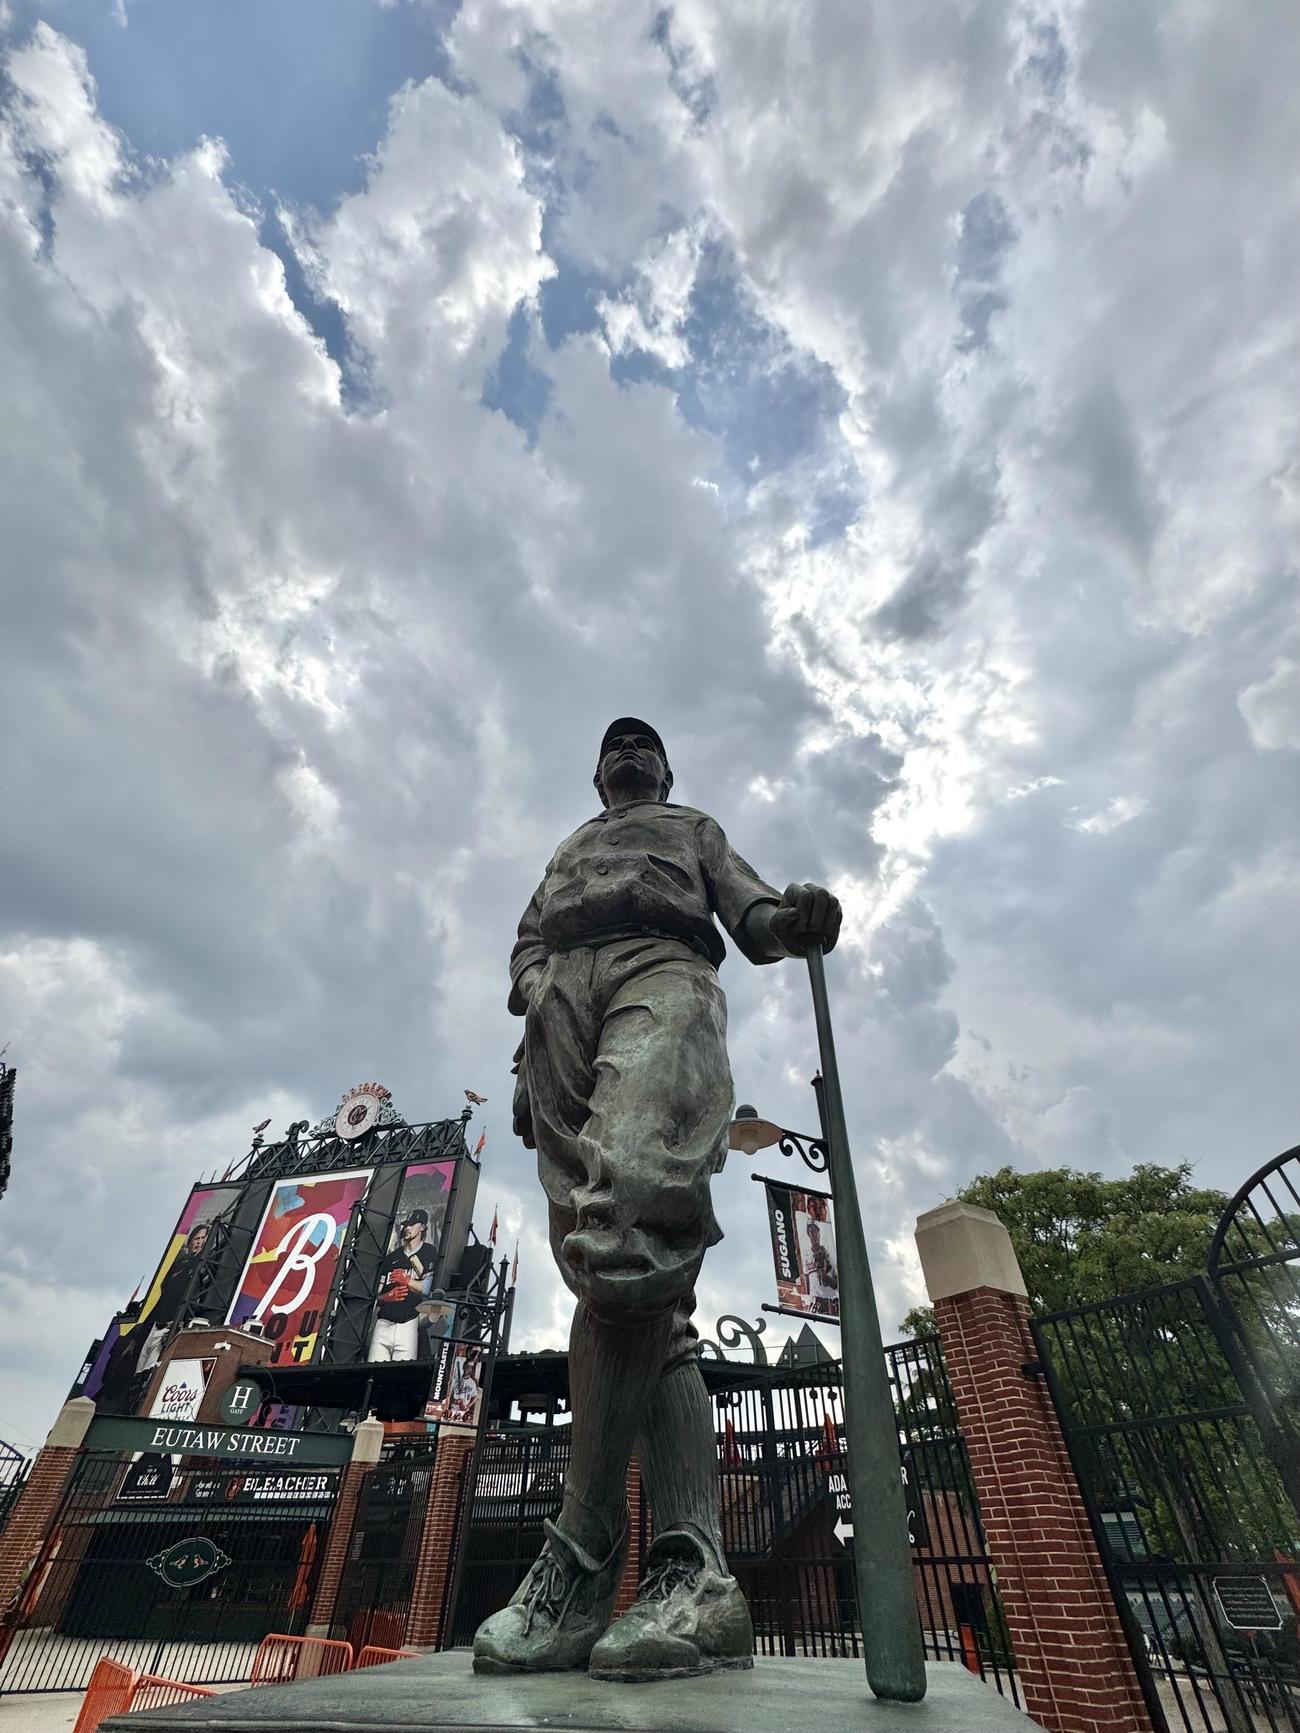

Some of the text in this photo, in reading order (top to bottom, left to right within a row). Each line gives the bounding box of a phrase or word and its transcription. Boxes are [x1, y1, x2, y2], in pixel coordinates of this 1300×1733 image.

[775, 1209, 791, 1279] SUGANO
[253, 1213, 337, 1321] B
[433, 1341, 450, 1400] MOUNTCASTLE
[161, 1384, 198, 1402] Coors
[228, 1386, 254, 1409] H
[161, 1402, 190, 1413] LIGHT
[150, 1427, 301, 1455] EUTAW STREET
[243, 1476, 328, 1492] BLEACHER
[828, 1473, 848, 1493] ADA
[836, 1494, 851, 1510] ACC
